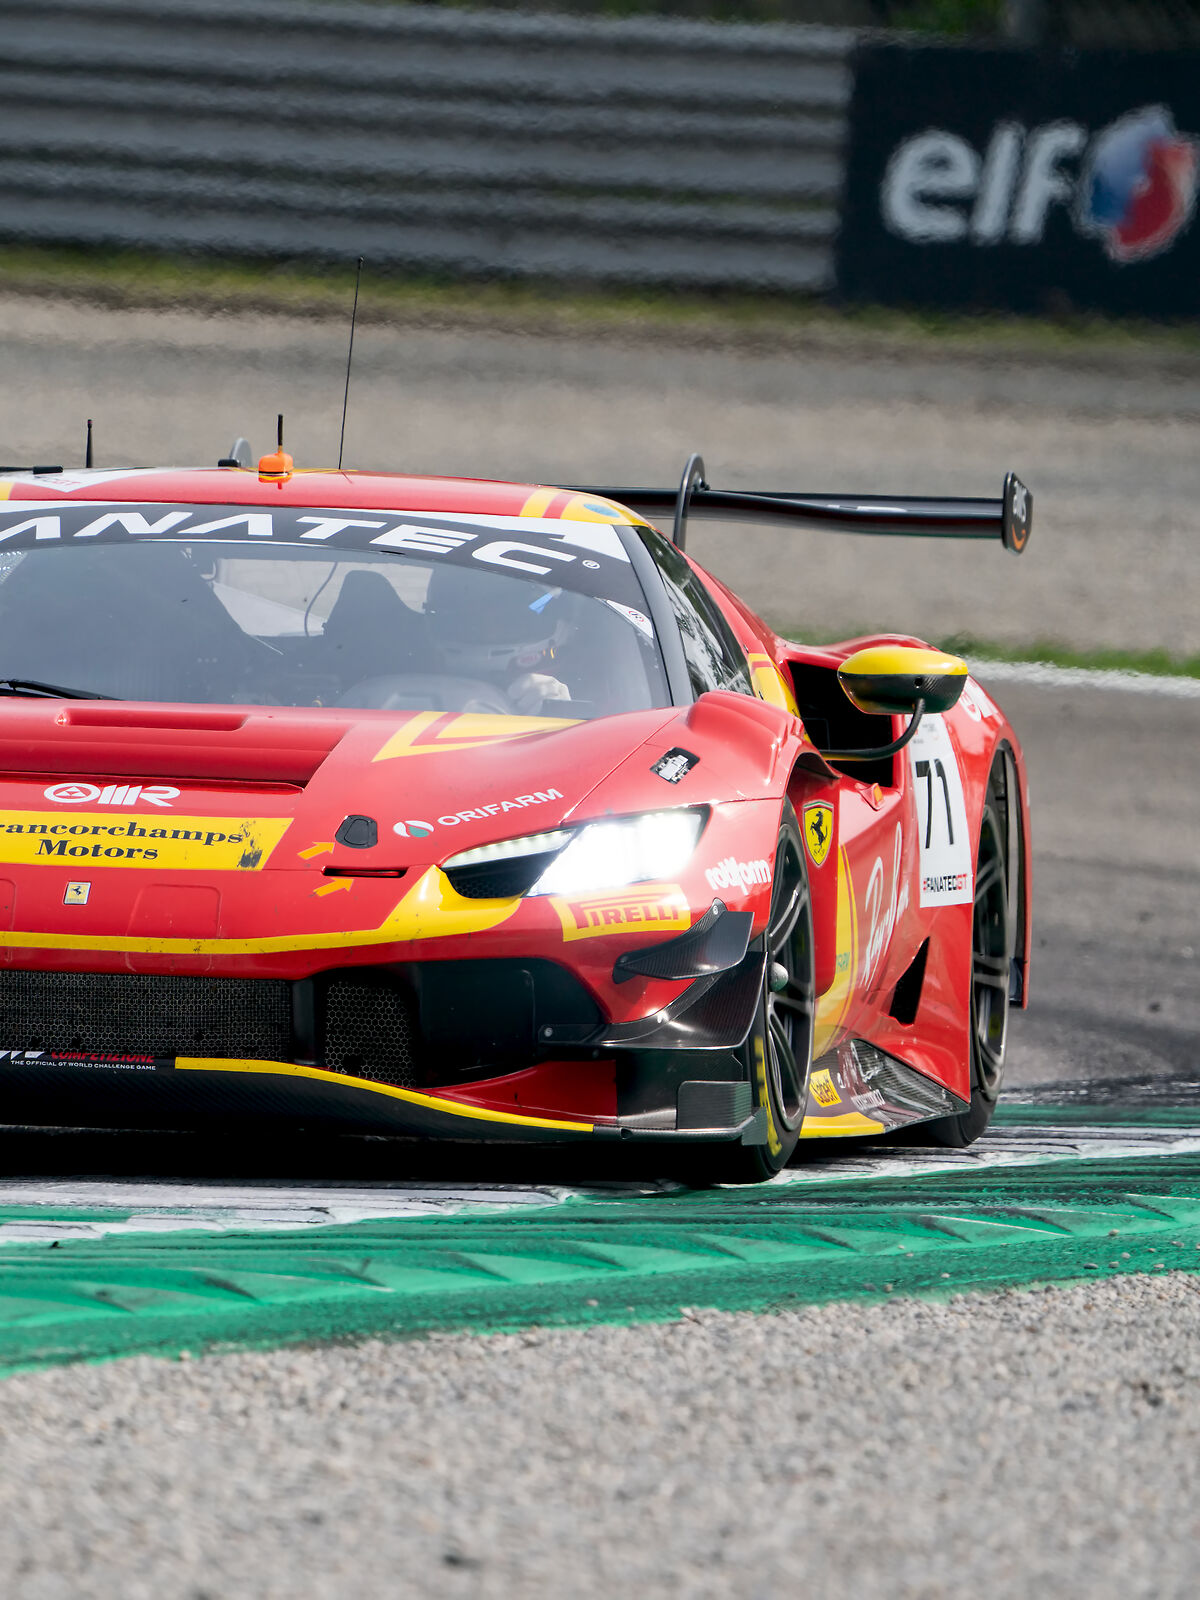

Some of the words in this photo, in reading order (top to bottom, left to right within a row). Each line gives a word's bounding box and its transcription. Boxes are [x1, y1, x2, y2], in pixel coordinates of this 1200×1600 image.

[882, 121, 1086, 246] elf
[437, 788, 564, 826] ORIFARM
[915, 758, 955, 849] 71
[35, 838, 159, 861] Motors
[568, 891, 681, 929] PIRELLI
